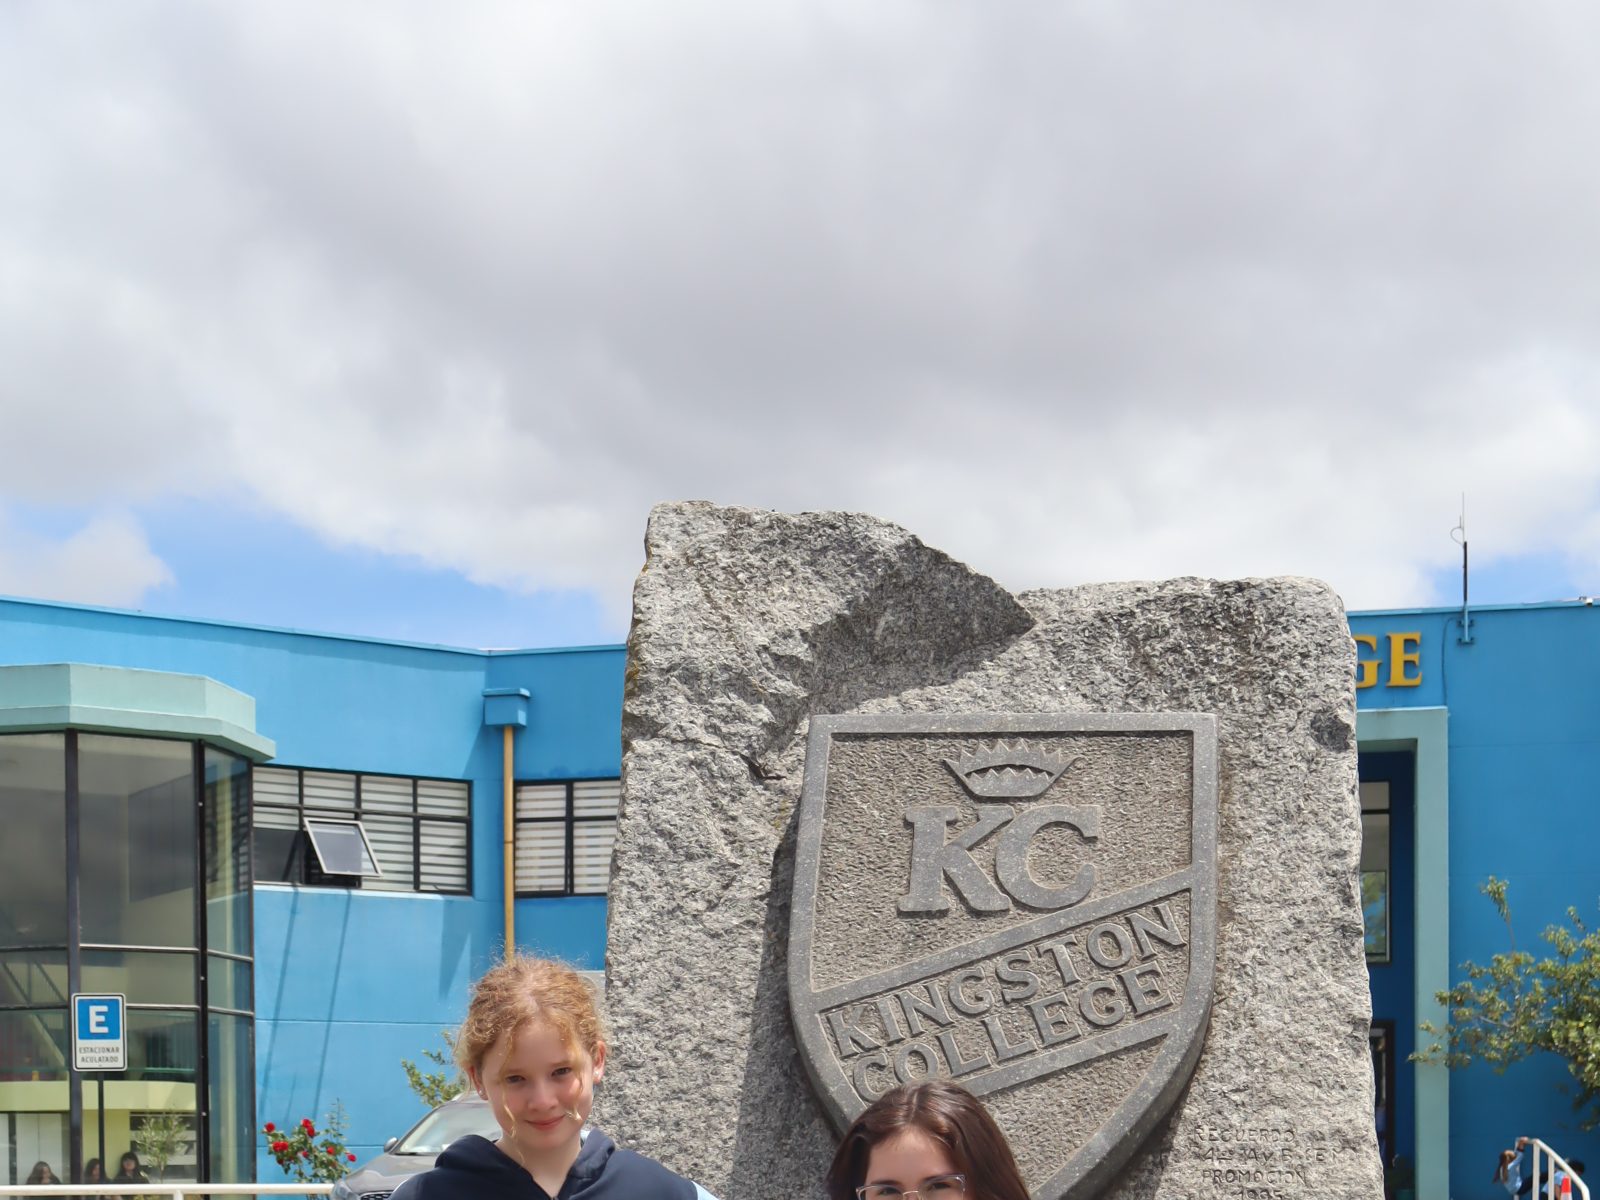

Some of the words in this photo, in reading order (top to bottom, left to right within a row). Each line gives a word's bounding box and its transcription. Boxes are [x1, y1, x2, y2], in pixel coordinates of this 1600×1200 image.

[897, 805, 1101, 913] KC
[823, 904, 1187, 1058] KINGSTON
[79, 1046, 120, 1054] ESTACIONAR
[88, 1005, 109, 1034] E
[853, 962, 1174, 1101] COLLEGE
[1194, 1127, 1296, 1143] RECUERDO
